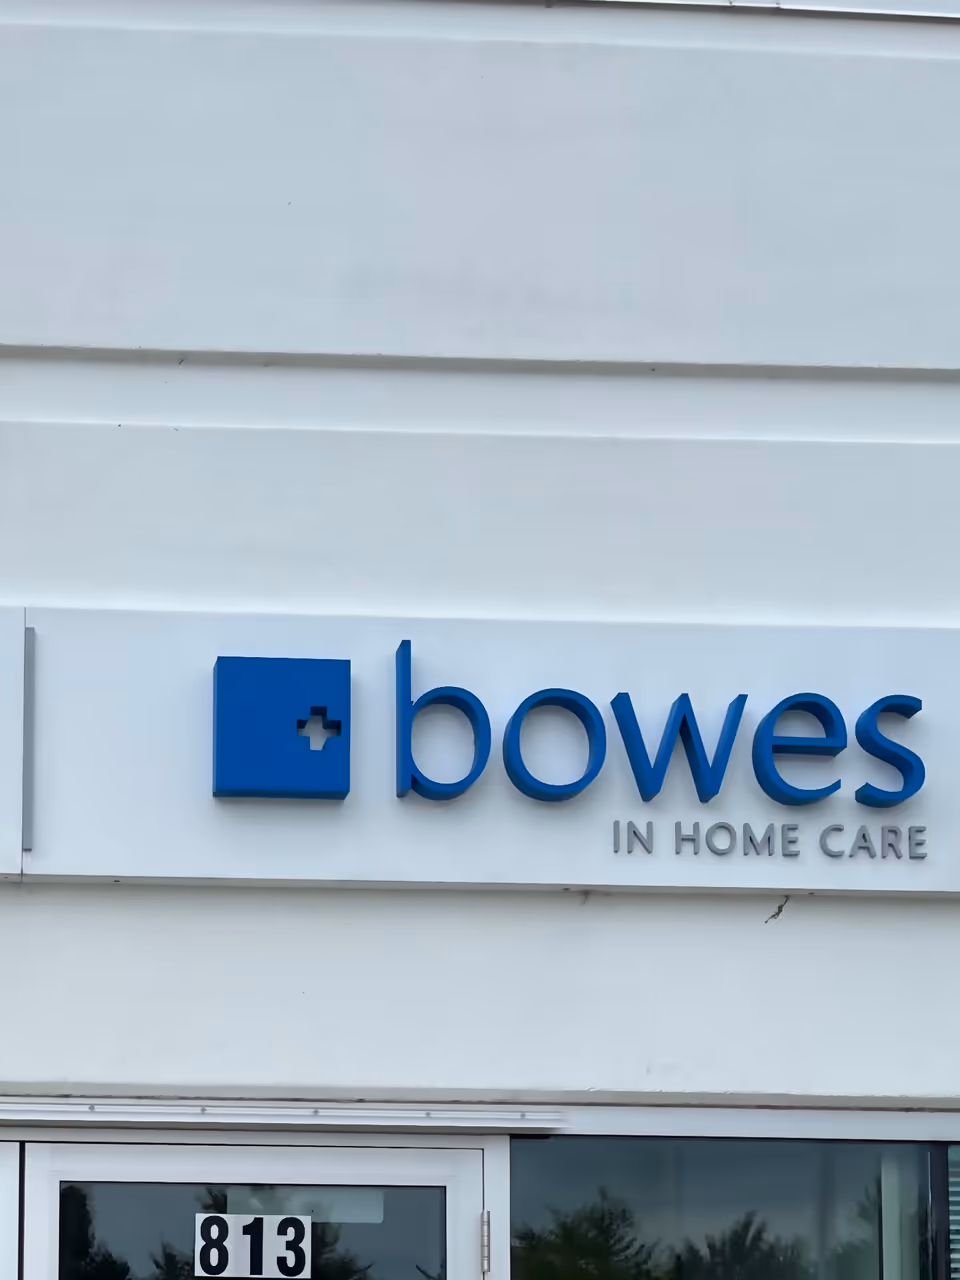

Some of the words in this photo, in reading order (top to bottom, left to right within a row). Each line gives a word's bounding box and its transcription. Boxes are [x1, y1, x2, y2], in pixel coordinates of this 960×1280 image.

[395, 639, 927, 808] bowes
[612, 819, 654, 855] IN
[674, 821, 800, 858] HOME
[818, 824, 928, 860] CARE
[199, 1214, 307, 1278] 813
